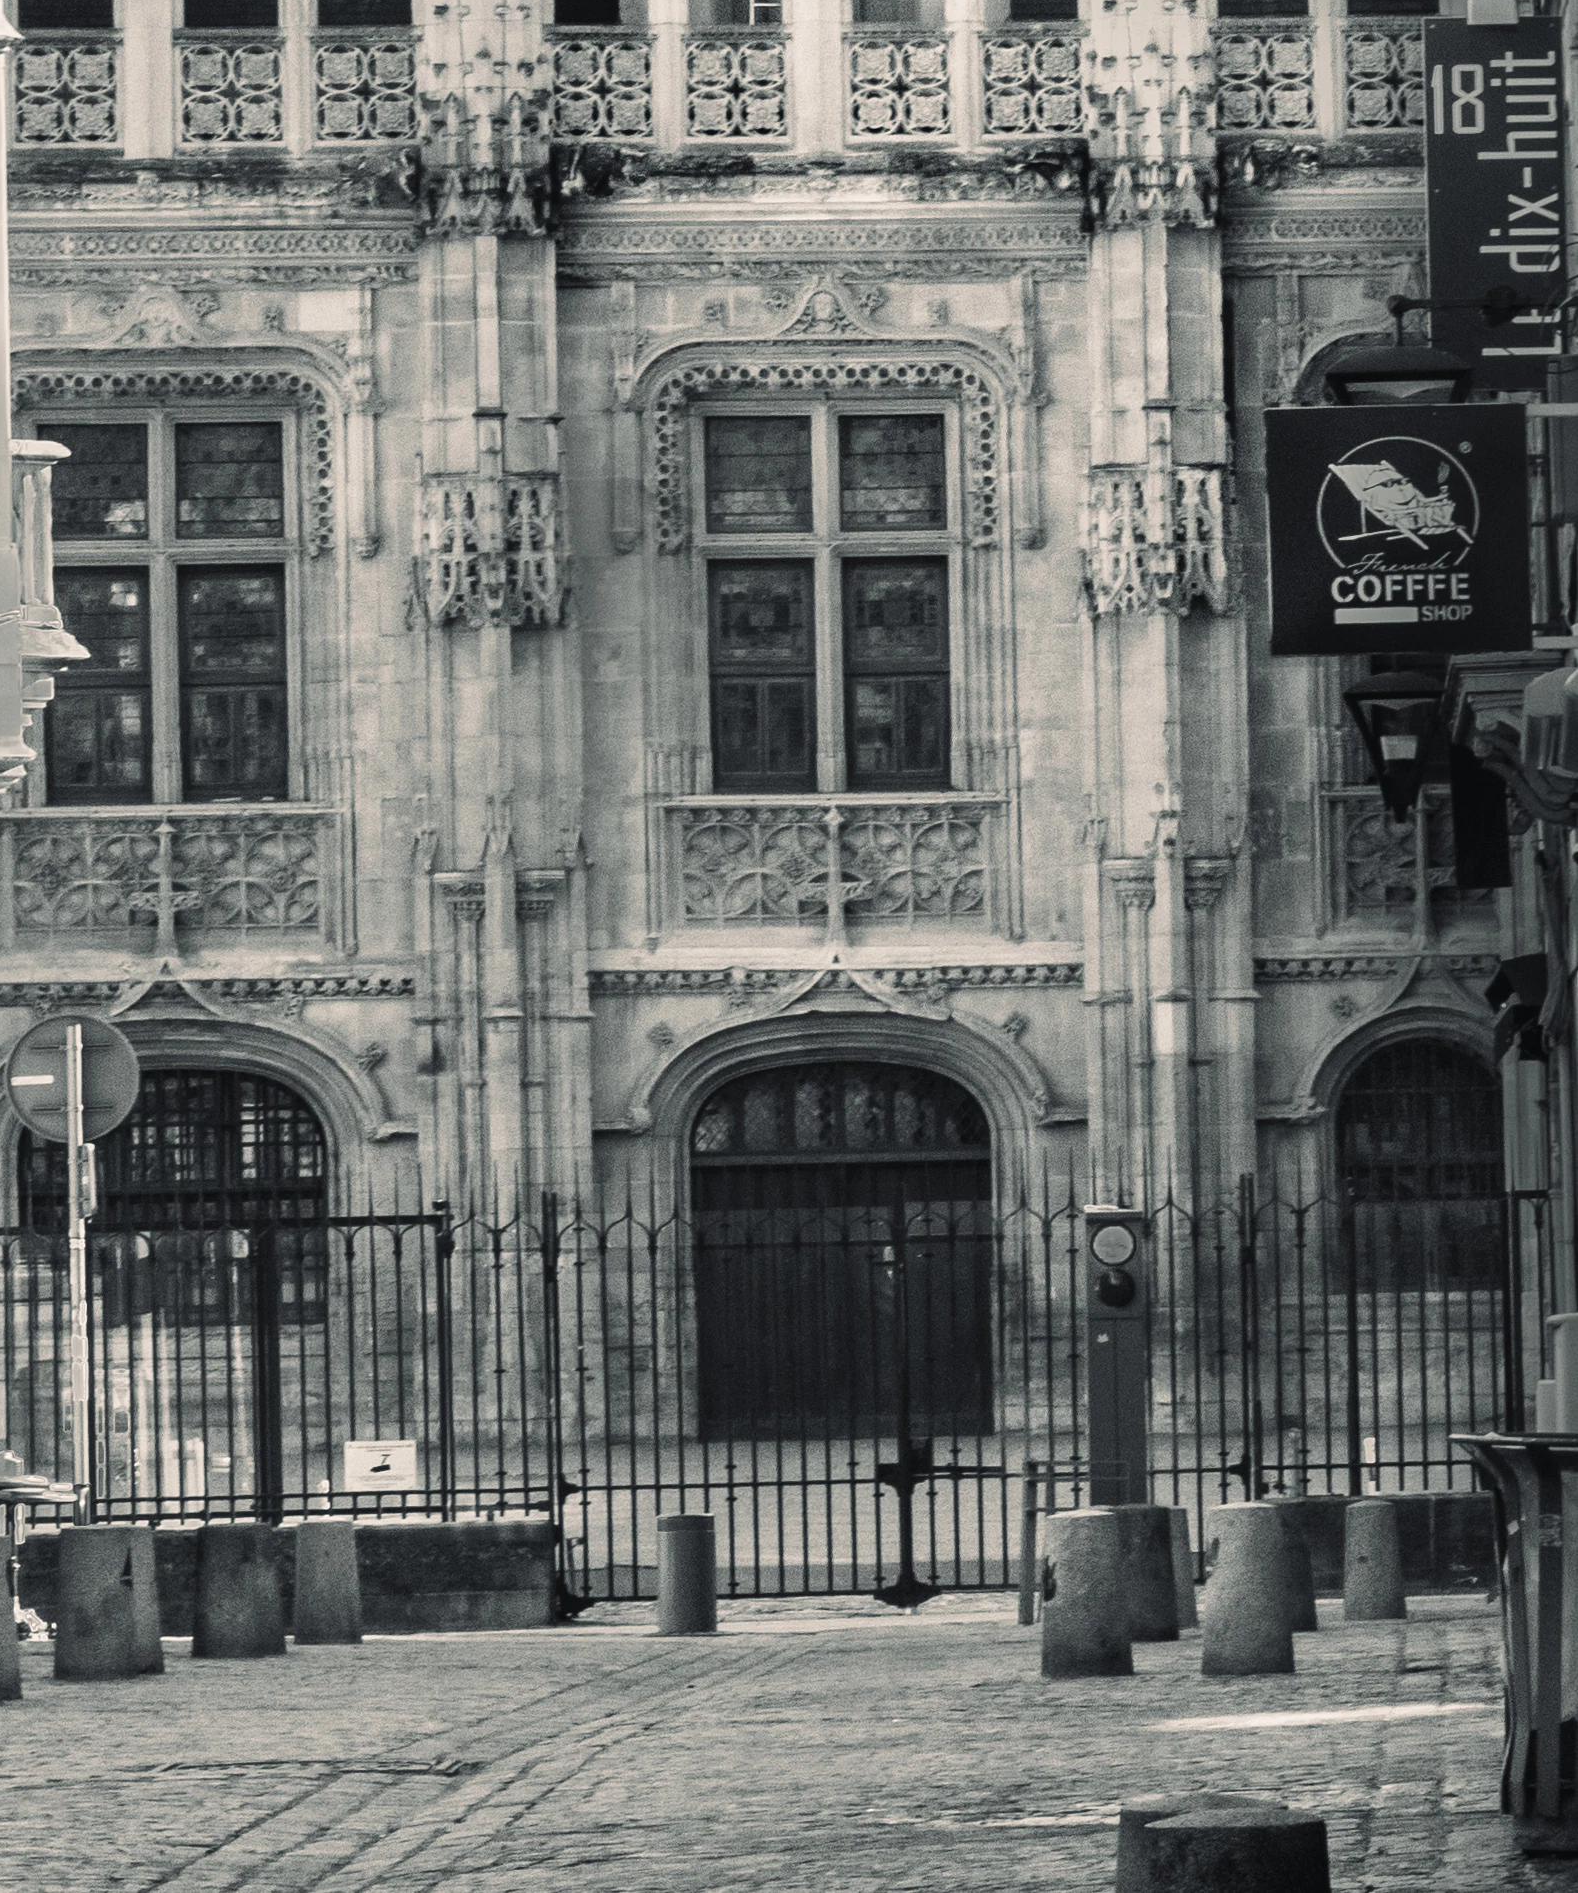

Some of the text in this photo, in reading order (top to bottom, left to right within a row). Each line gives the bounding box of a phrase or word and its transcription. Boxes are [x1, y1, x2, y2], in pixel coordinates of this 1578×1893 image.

[1431, 63, 1485, 135] 18
[1477, 51, 1560, 273] dix-huit
[1331, 573, 1470, 603] COFFFE
[1421, 605, 1473, 621] SHOP
